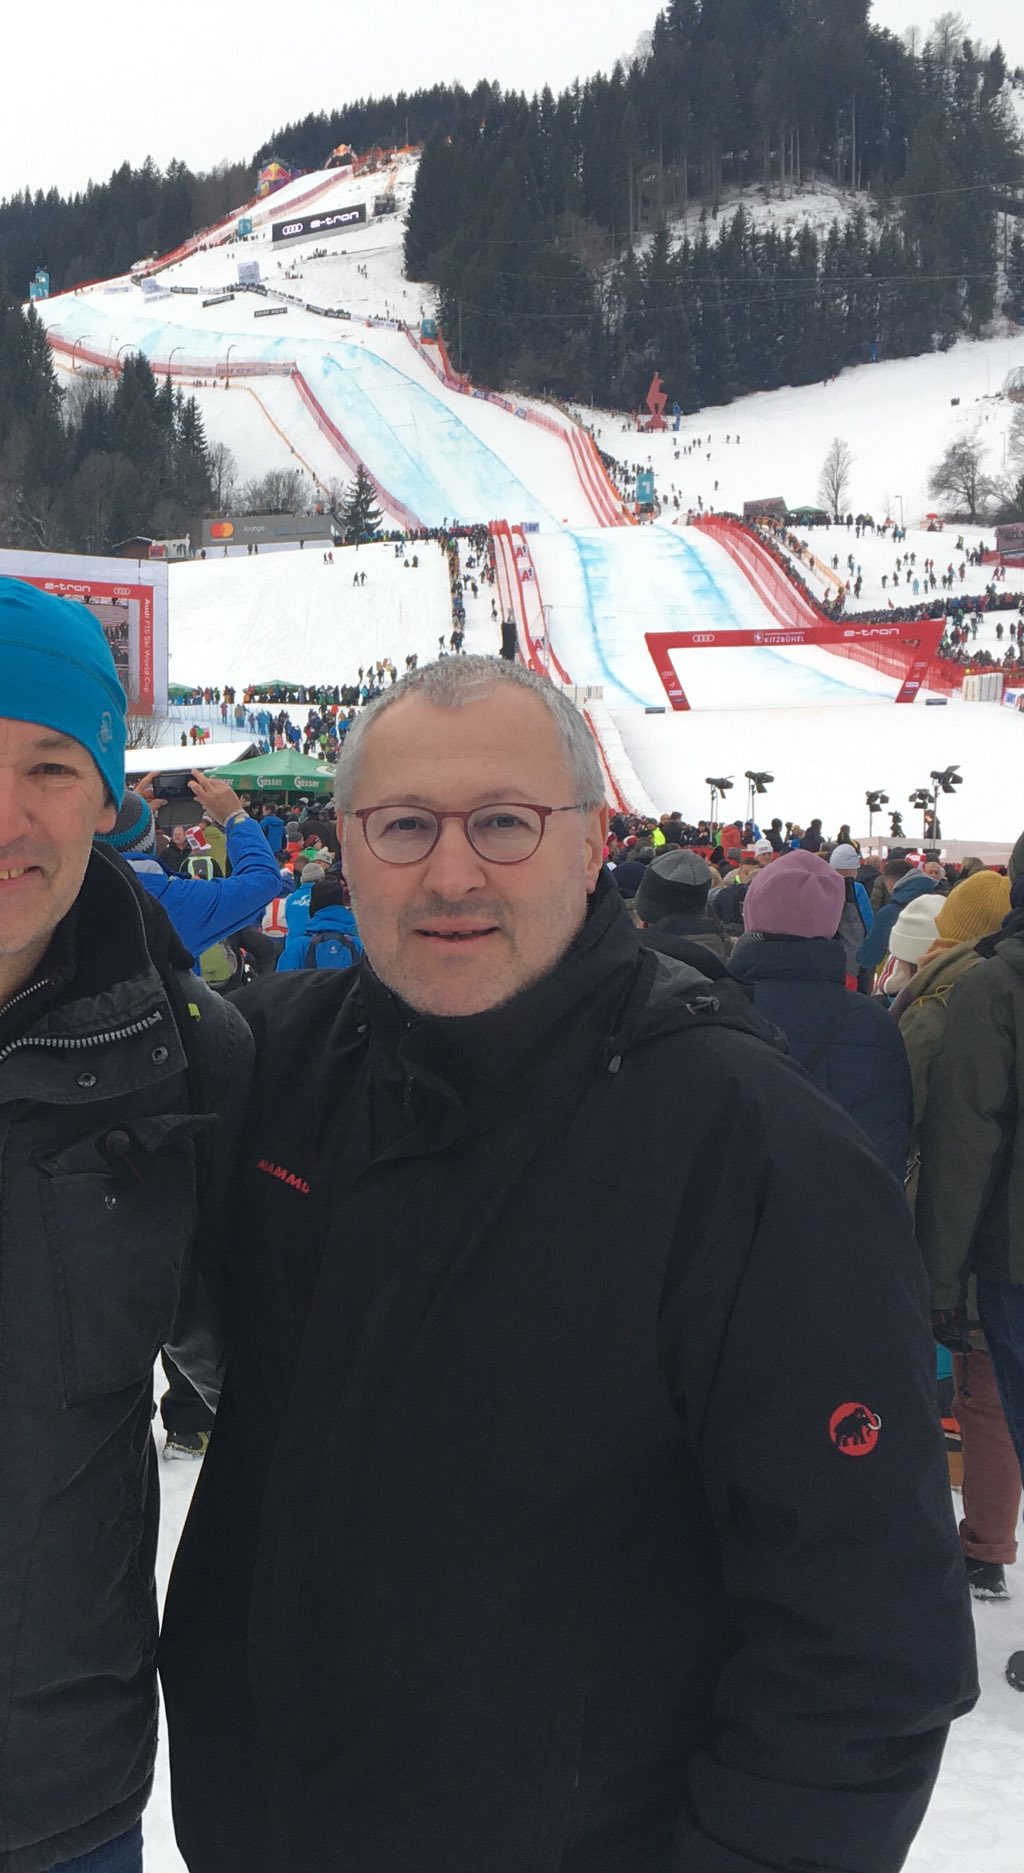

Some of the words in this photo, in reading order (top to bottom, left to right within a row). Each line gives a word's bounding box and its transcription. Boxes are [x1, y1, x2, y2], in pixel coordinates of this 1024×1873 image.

[310, 210, 359, 229] e-tron
[44, 582, 91, 593] e-tron
[143, 598, 151, 619] Audi
[764, 634, 805, 643] KITZBÜHEL
[843, 628, 900, 637] e-tron
[143, 649, 151, 675] World
[143, 676, 151, 693] Cup
